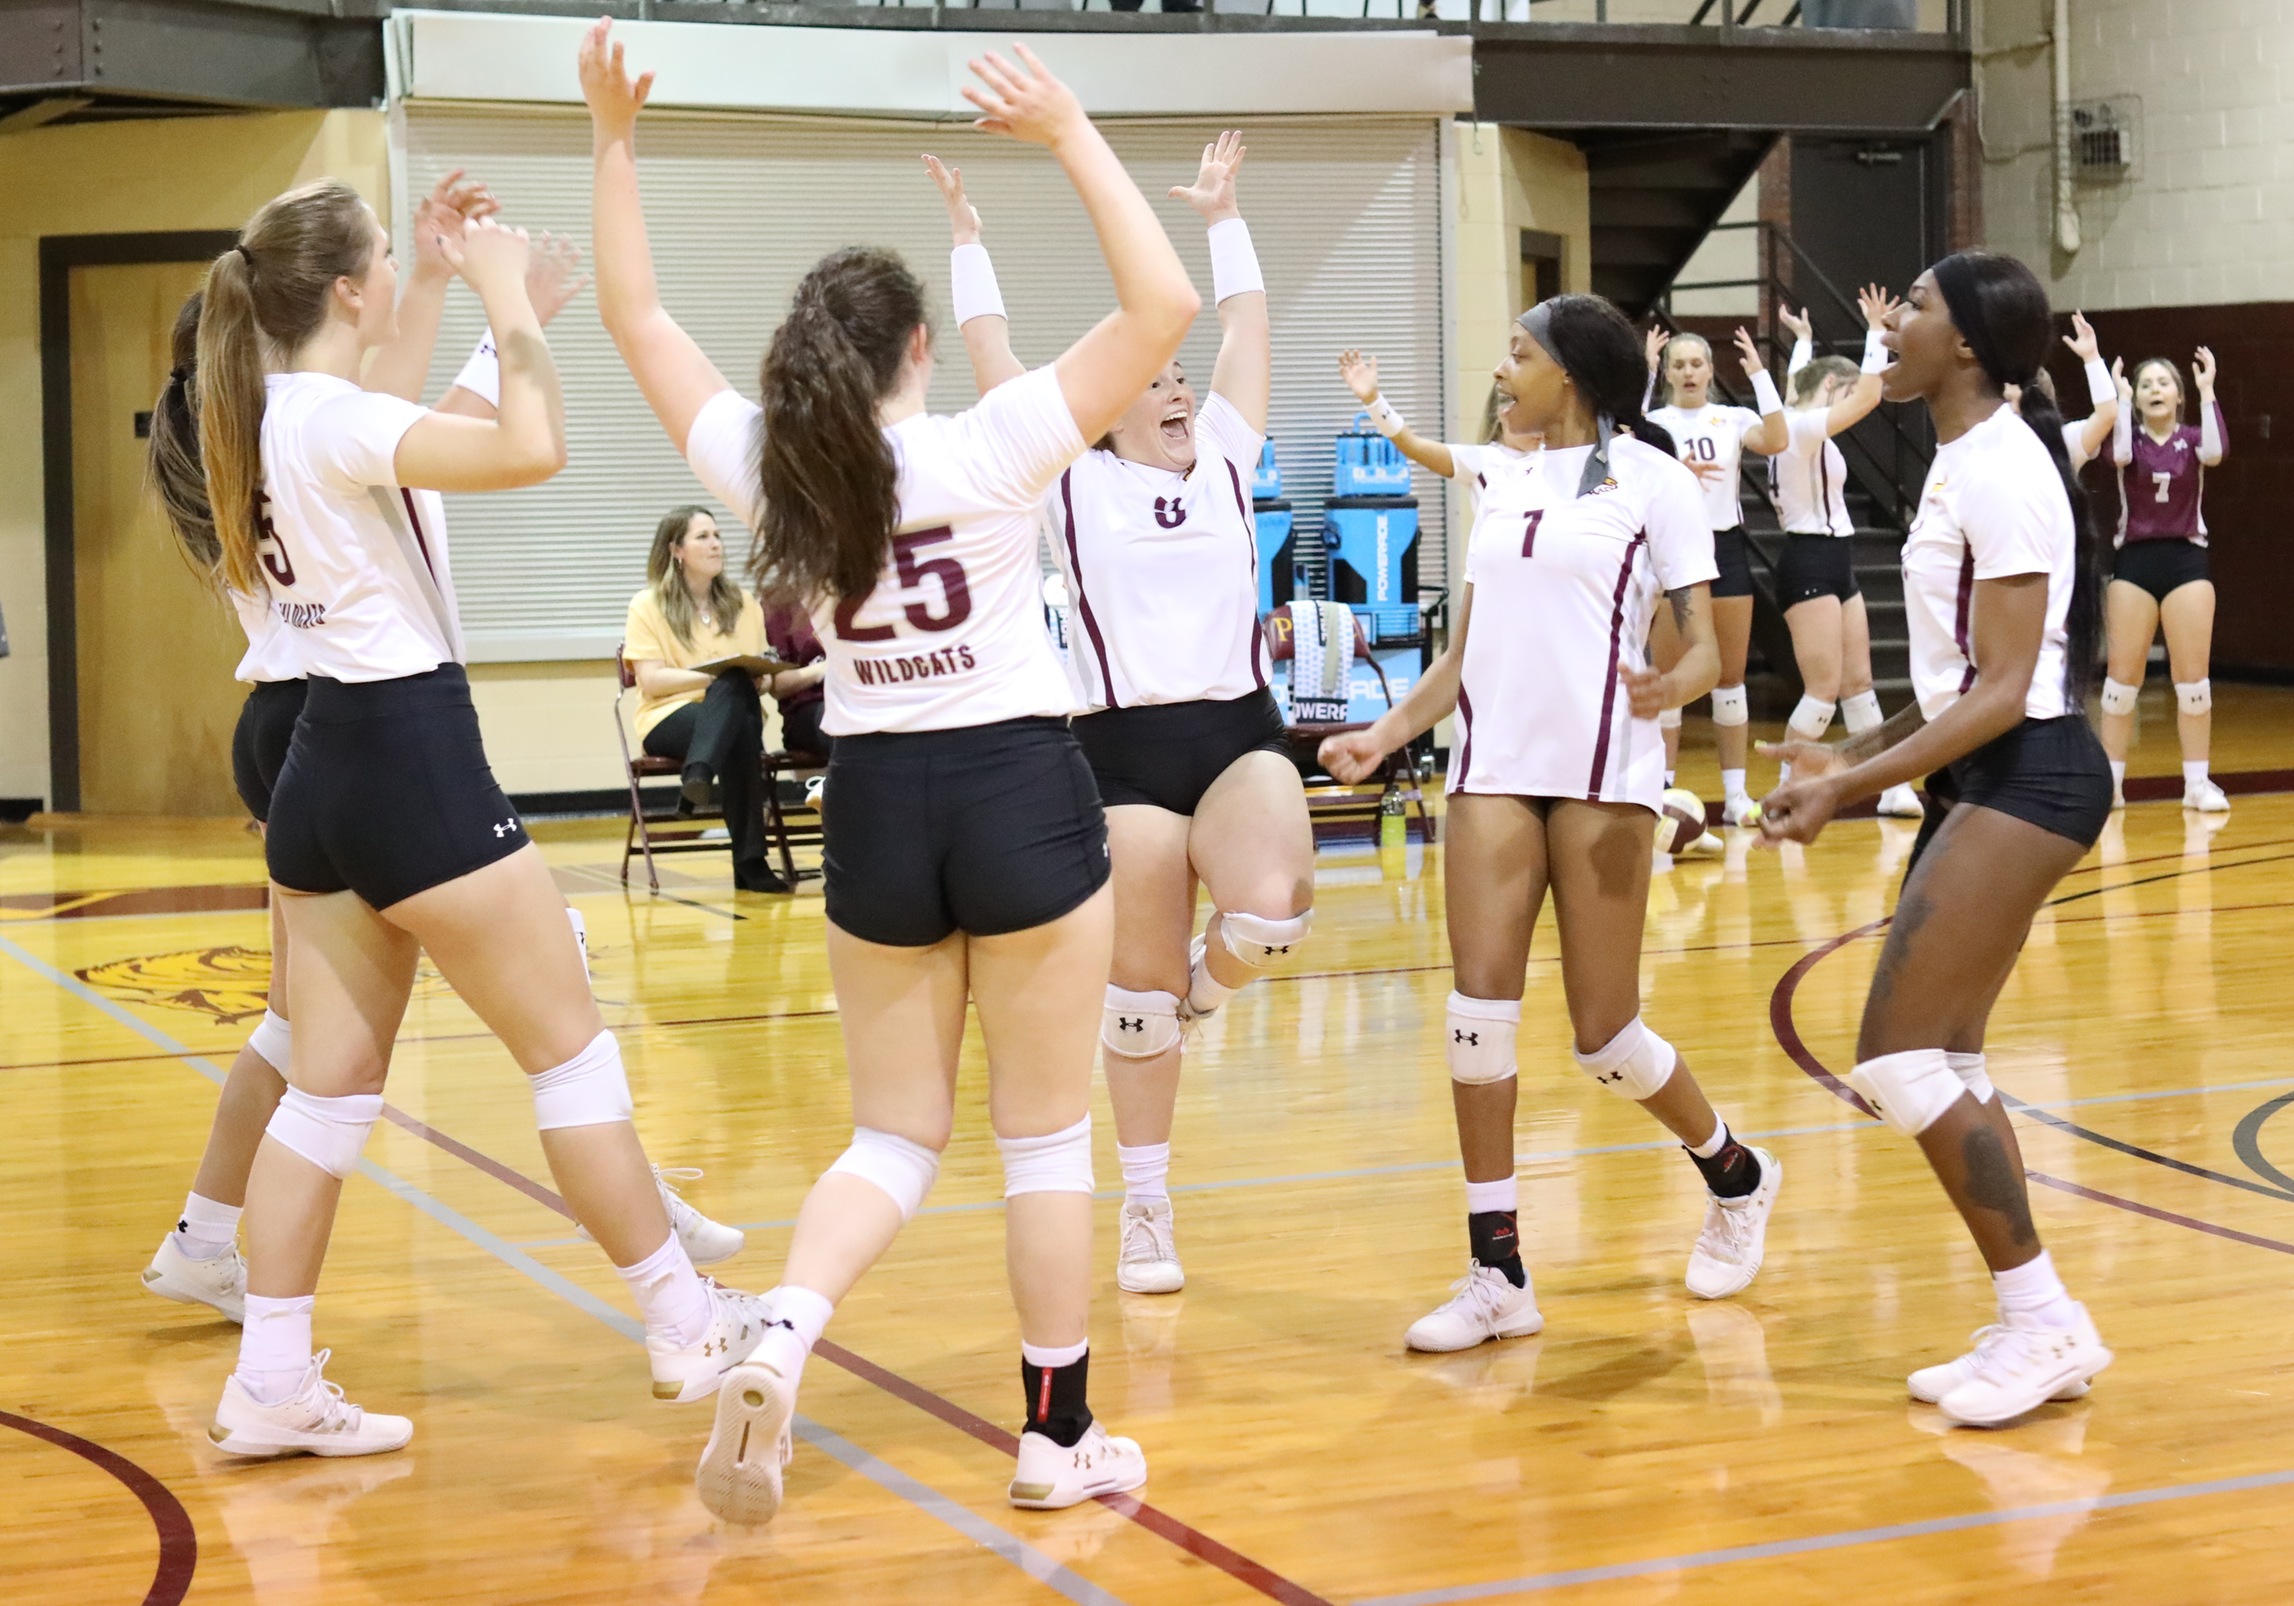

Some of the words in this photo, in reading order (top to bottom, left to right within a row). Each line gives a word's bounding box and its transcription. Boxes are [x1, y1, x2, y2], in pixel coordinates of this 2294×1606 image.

[1684, 437, 1716, 461] 10
[2152, 471, 2171, 503] 7
[1377, 514, 1389, 602] POWERADE
[833, 524, 972, 642] 25
[853, 645, 976, 686] WILDCATS
